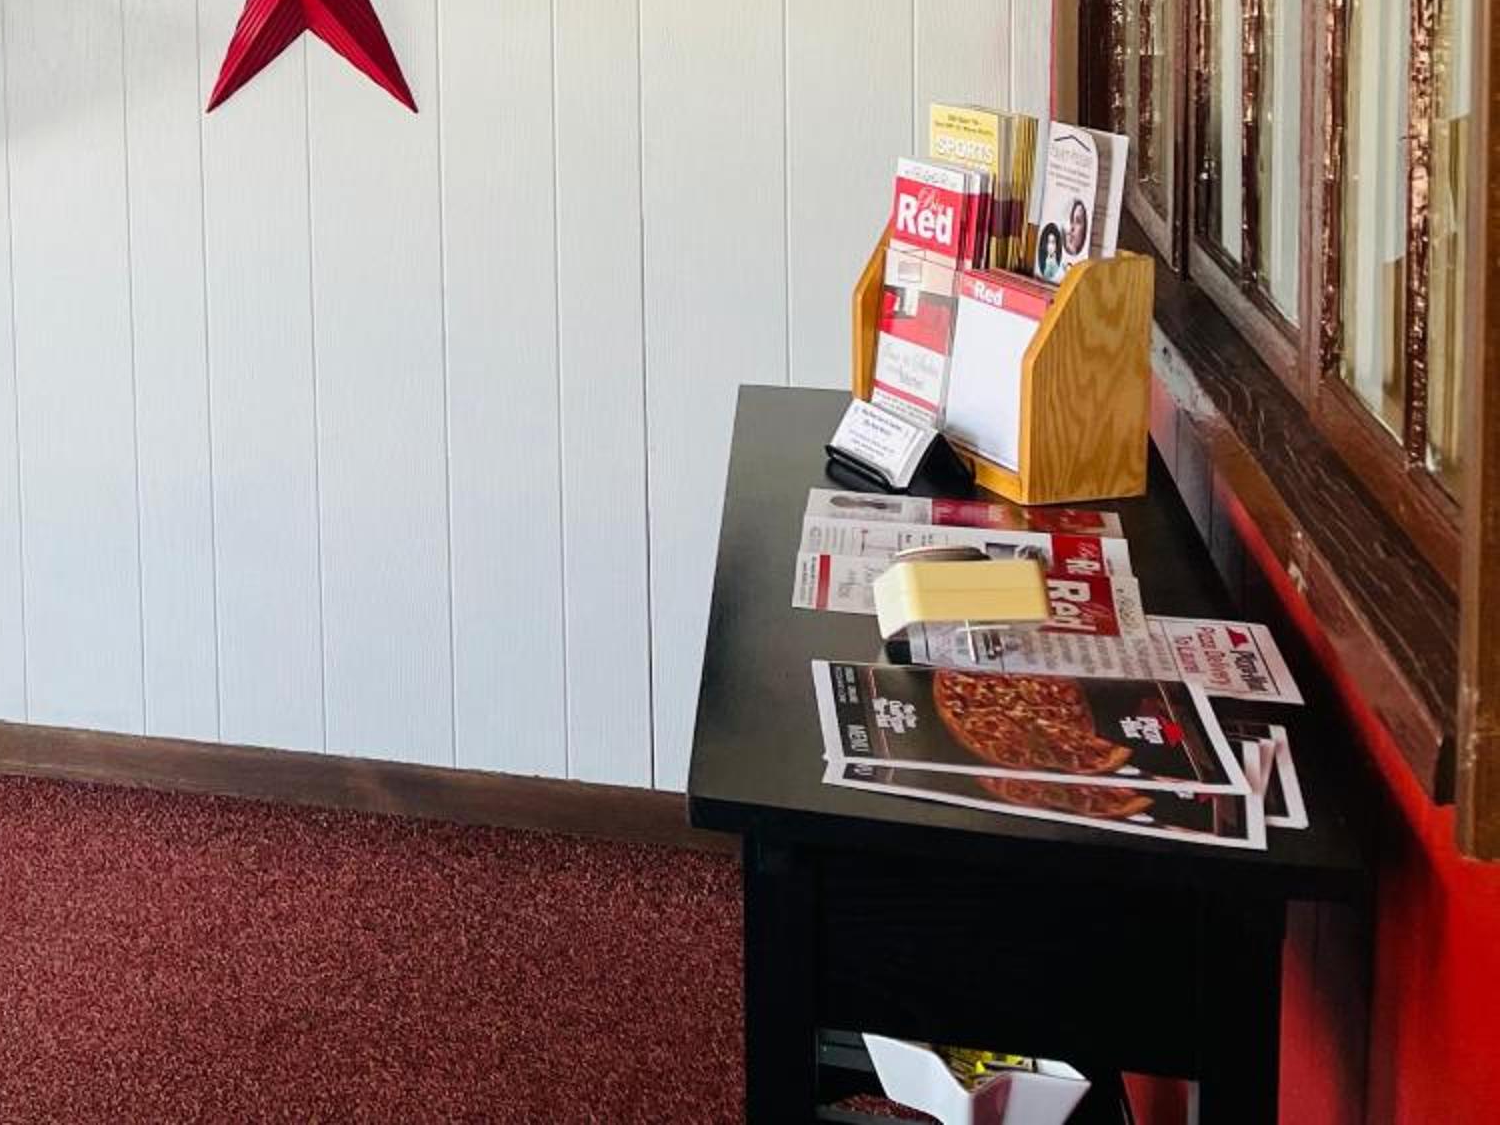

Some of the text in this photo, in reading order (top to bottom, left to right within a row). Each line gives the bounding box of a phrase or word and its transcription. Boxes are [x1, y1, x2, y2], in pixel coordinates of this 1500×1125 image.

[896, 192, 954, 246] Red
[975, 280, 1003, 307] Red
[1044, 578, 1098, 631] Red
[1195, 626, 1232, 686] Pizza Delivery
[1228, 650, 1258, 674] Pizza
[847, 724, 870, 753] MENU
